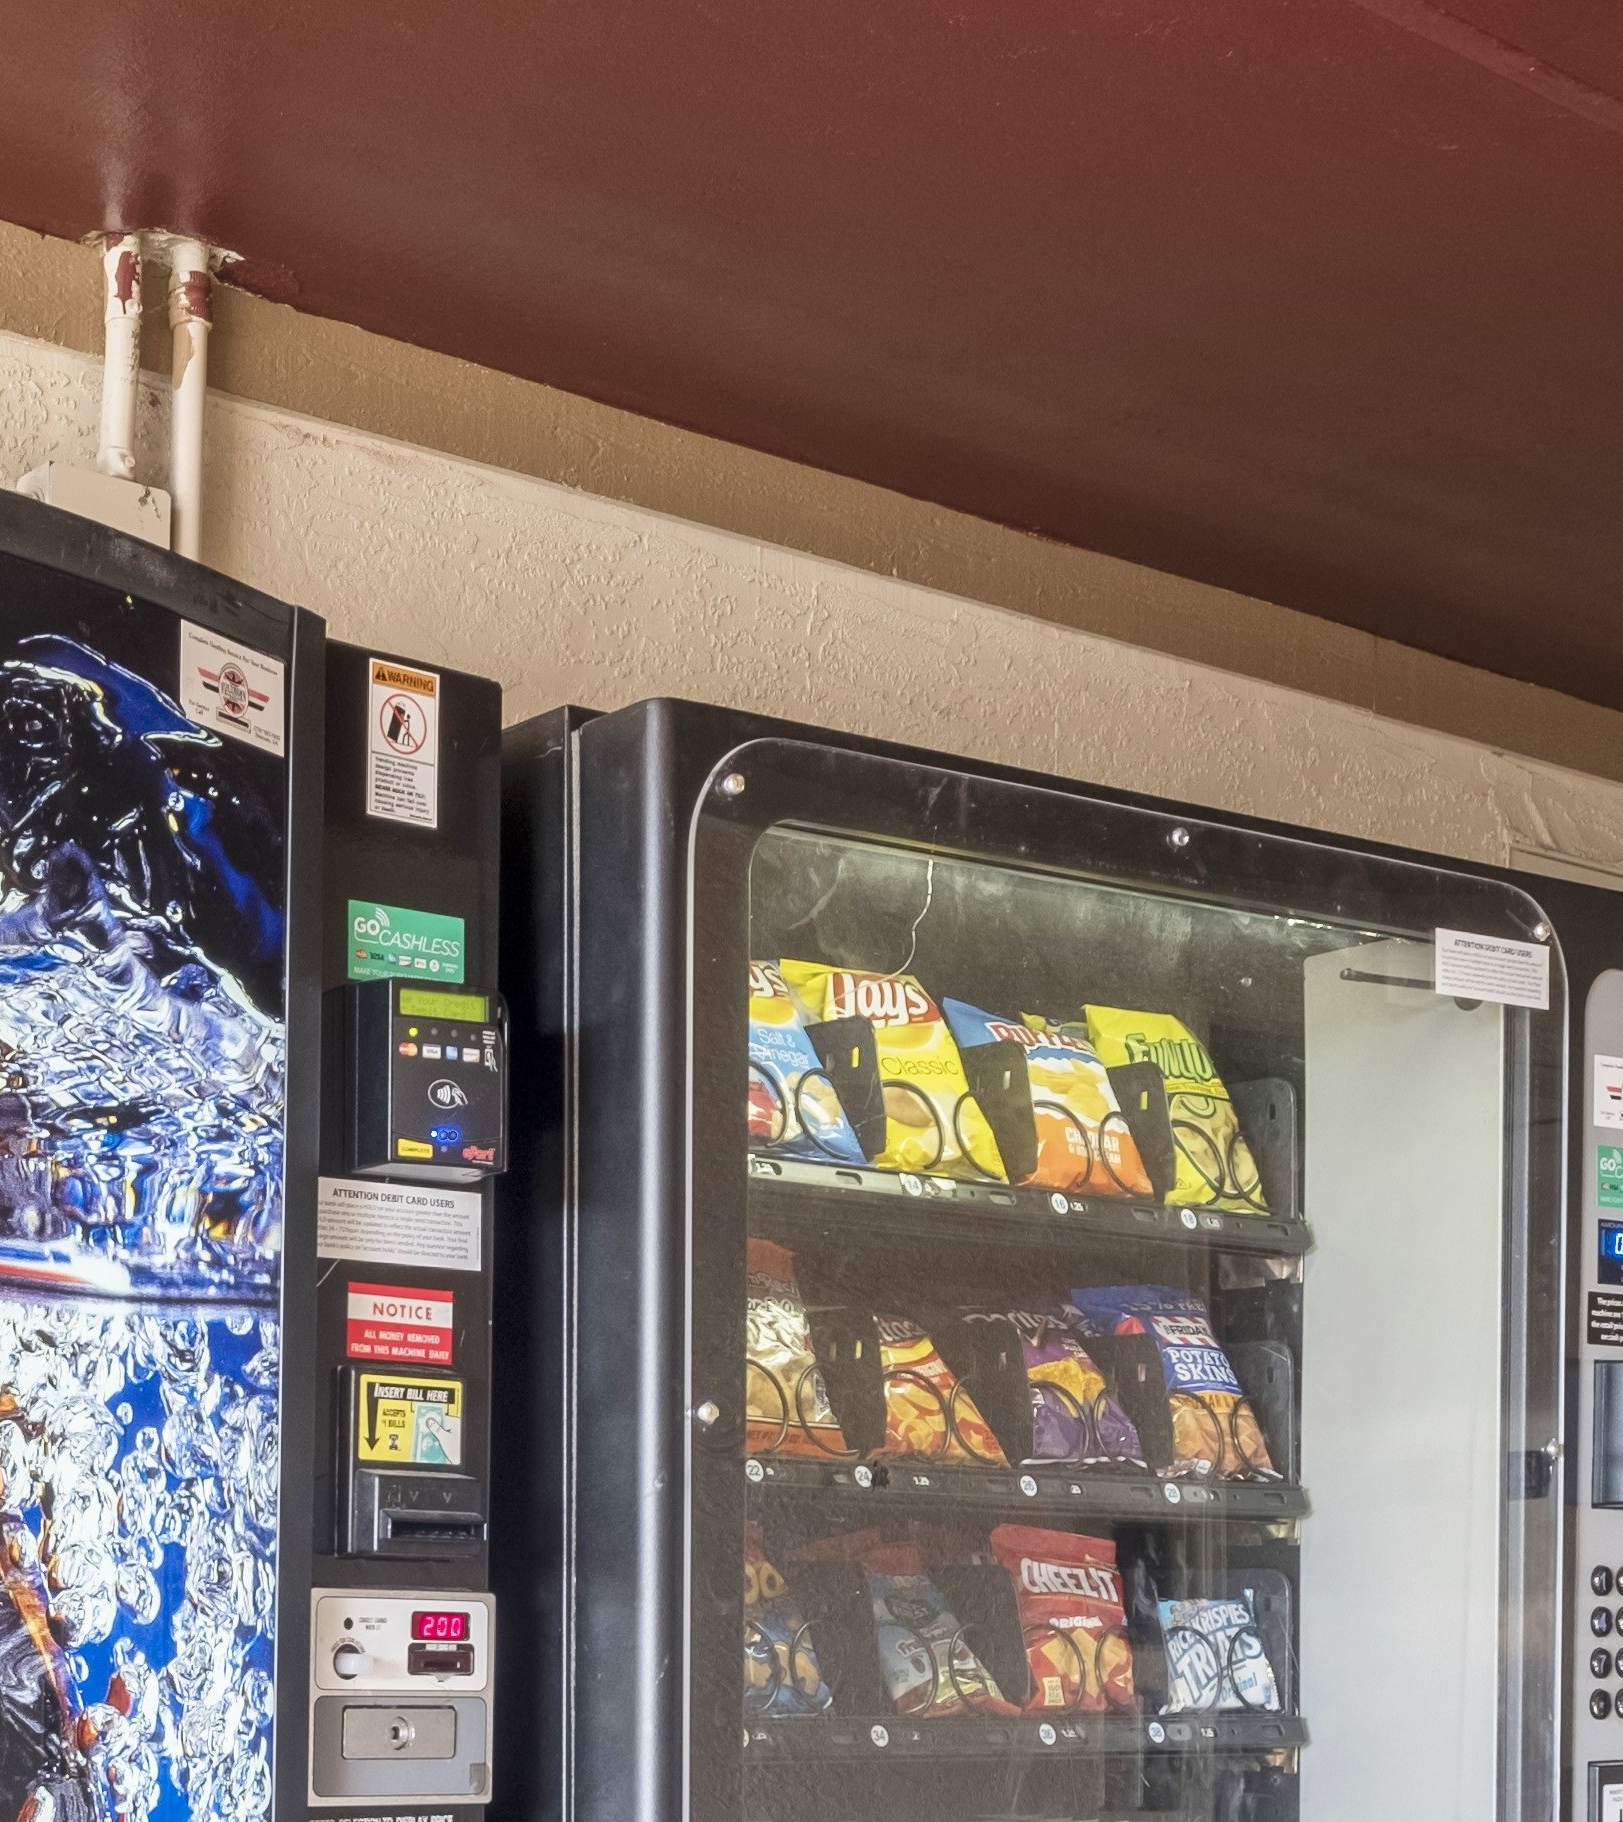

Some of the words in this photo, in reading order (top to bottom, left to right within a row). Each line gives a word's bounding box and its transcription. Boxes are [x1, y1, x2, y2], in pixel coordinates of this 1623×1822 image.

[387, 670, 434, 692] WARNING
[354, 917, 380, 936] GO
[379, 930, 460, 957] CASHLESS
[1454, 939, 1484, 950] ATTENTION
[1485, 944, 1500, 953] DEBIT
[1501, 946, 1516, 956] CARD
[1516, 949, 1533, 958] USERS
[758, 1029, 784, 1044] Salt
[786, 1034, 795, 1048] &
[750, 1043, 810, 1066] Vinegar
[881, 1057, 958, 1075] Classic
[1600, 1156, 1616, 1171] GO
[333, 1188, 378, 1201] ATTENTION
[380, 1193, 403, 1204] DEBIT
[406, 1196, 428, 1206] CARD
[430, 1198, 455, 1209] USERS
[1054, 1197, 1066, 1210] 16
[372, 1302, 432, 1320] NOTICE
[364, 1329, 376, 1339] ALL
[379, 1331, 404, 1341] MONEY
[407, 1333, 440, 1345] REMOVED
[351, 1343, 371, 1354] FROM
[374, 1345, 389, 1354] THIS
[391, 1347, 426, 1358] MACHINE
[429, 1350, 449, 1360] DAILY
[1170, 1349, 1230, 1367] POTATO
[1175, 1363, 1238, 1385] SKINS
[406, 1387, 424, 1400] BILL
[426, 1390, 448, 1402] HERE
[388, 1420, 405, 1428] BILLS
[747, 1464, 761, 1477] 22
[857, 1470, 870, 1483] 24
[1193, 1603, 1250, 1635] KRISPIES
[873, 1729, 886, 1742] 34
[1041, 1727, 1054, 1740] 36
[1151, 1727, 1163, 1739] 38
